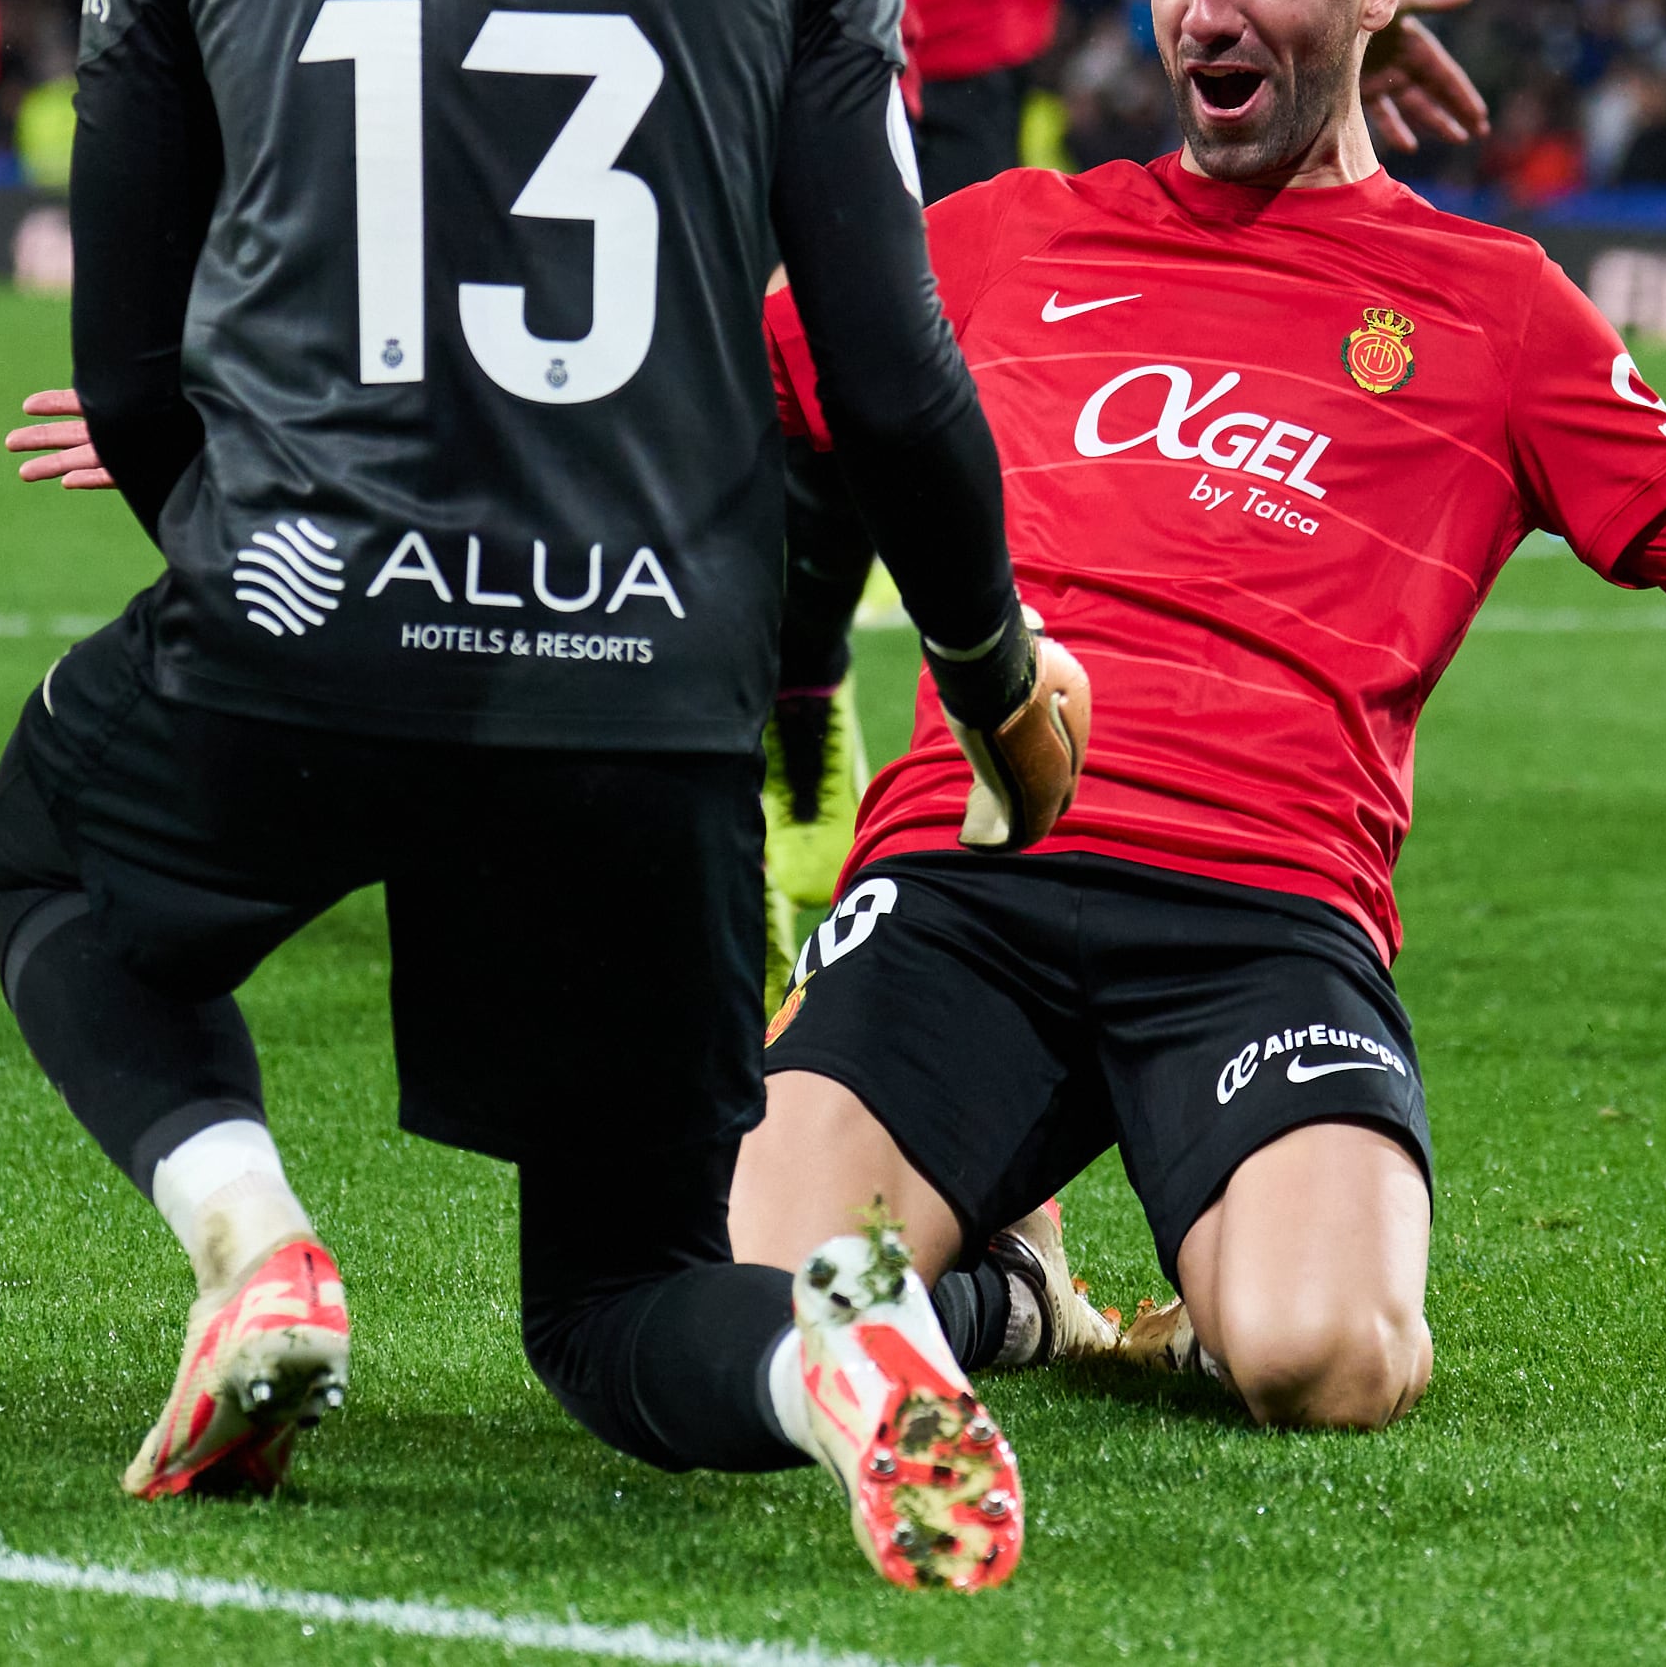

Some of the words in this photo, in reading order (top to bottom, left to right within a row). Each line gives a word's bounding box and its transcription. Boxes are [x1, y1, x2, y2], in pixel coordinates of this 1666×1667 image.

[1189, 473, 1234, 511] by
[1241, 487, 1320, 536] Taica
[365, 530, 686, 619] ALUA
[401, 622, 505, 654] HOTELS
[510, 629, 531, 656] &
[536, 632, 654, 664] RESORTS
[1263, 1024, 1407, 1077] AirEuropa
